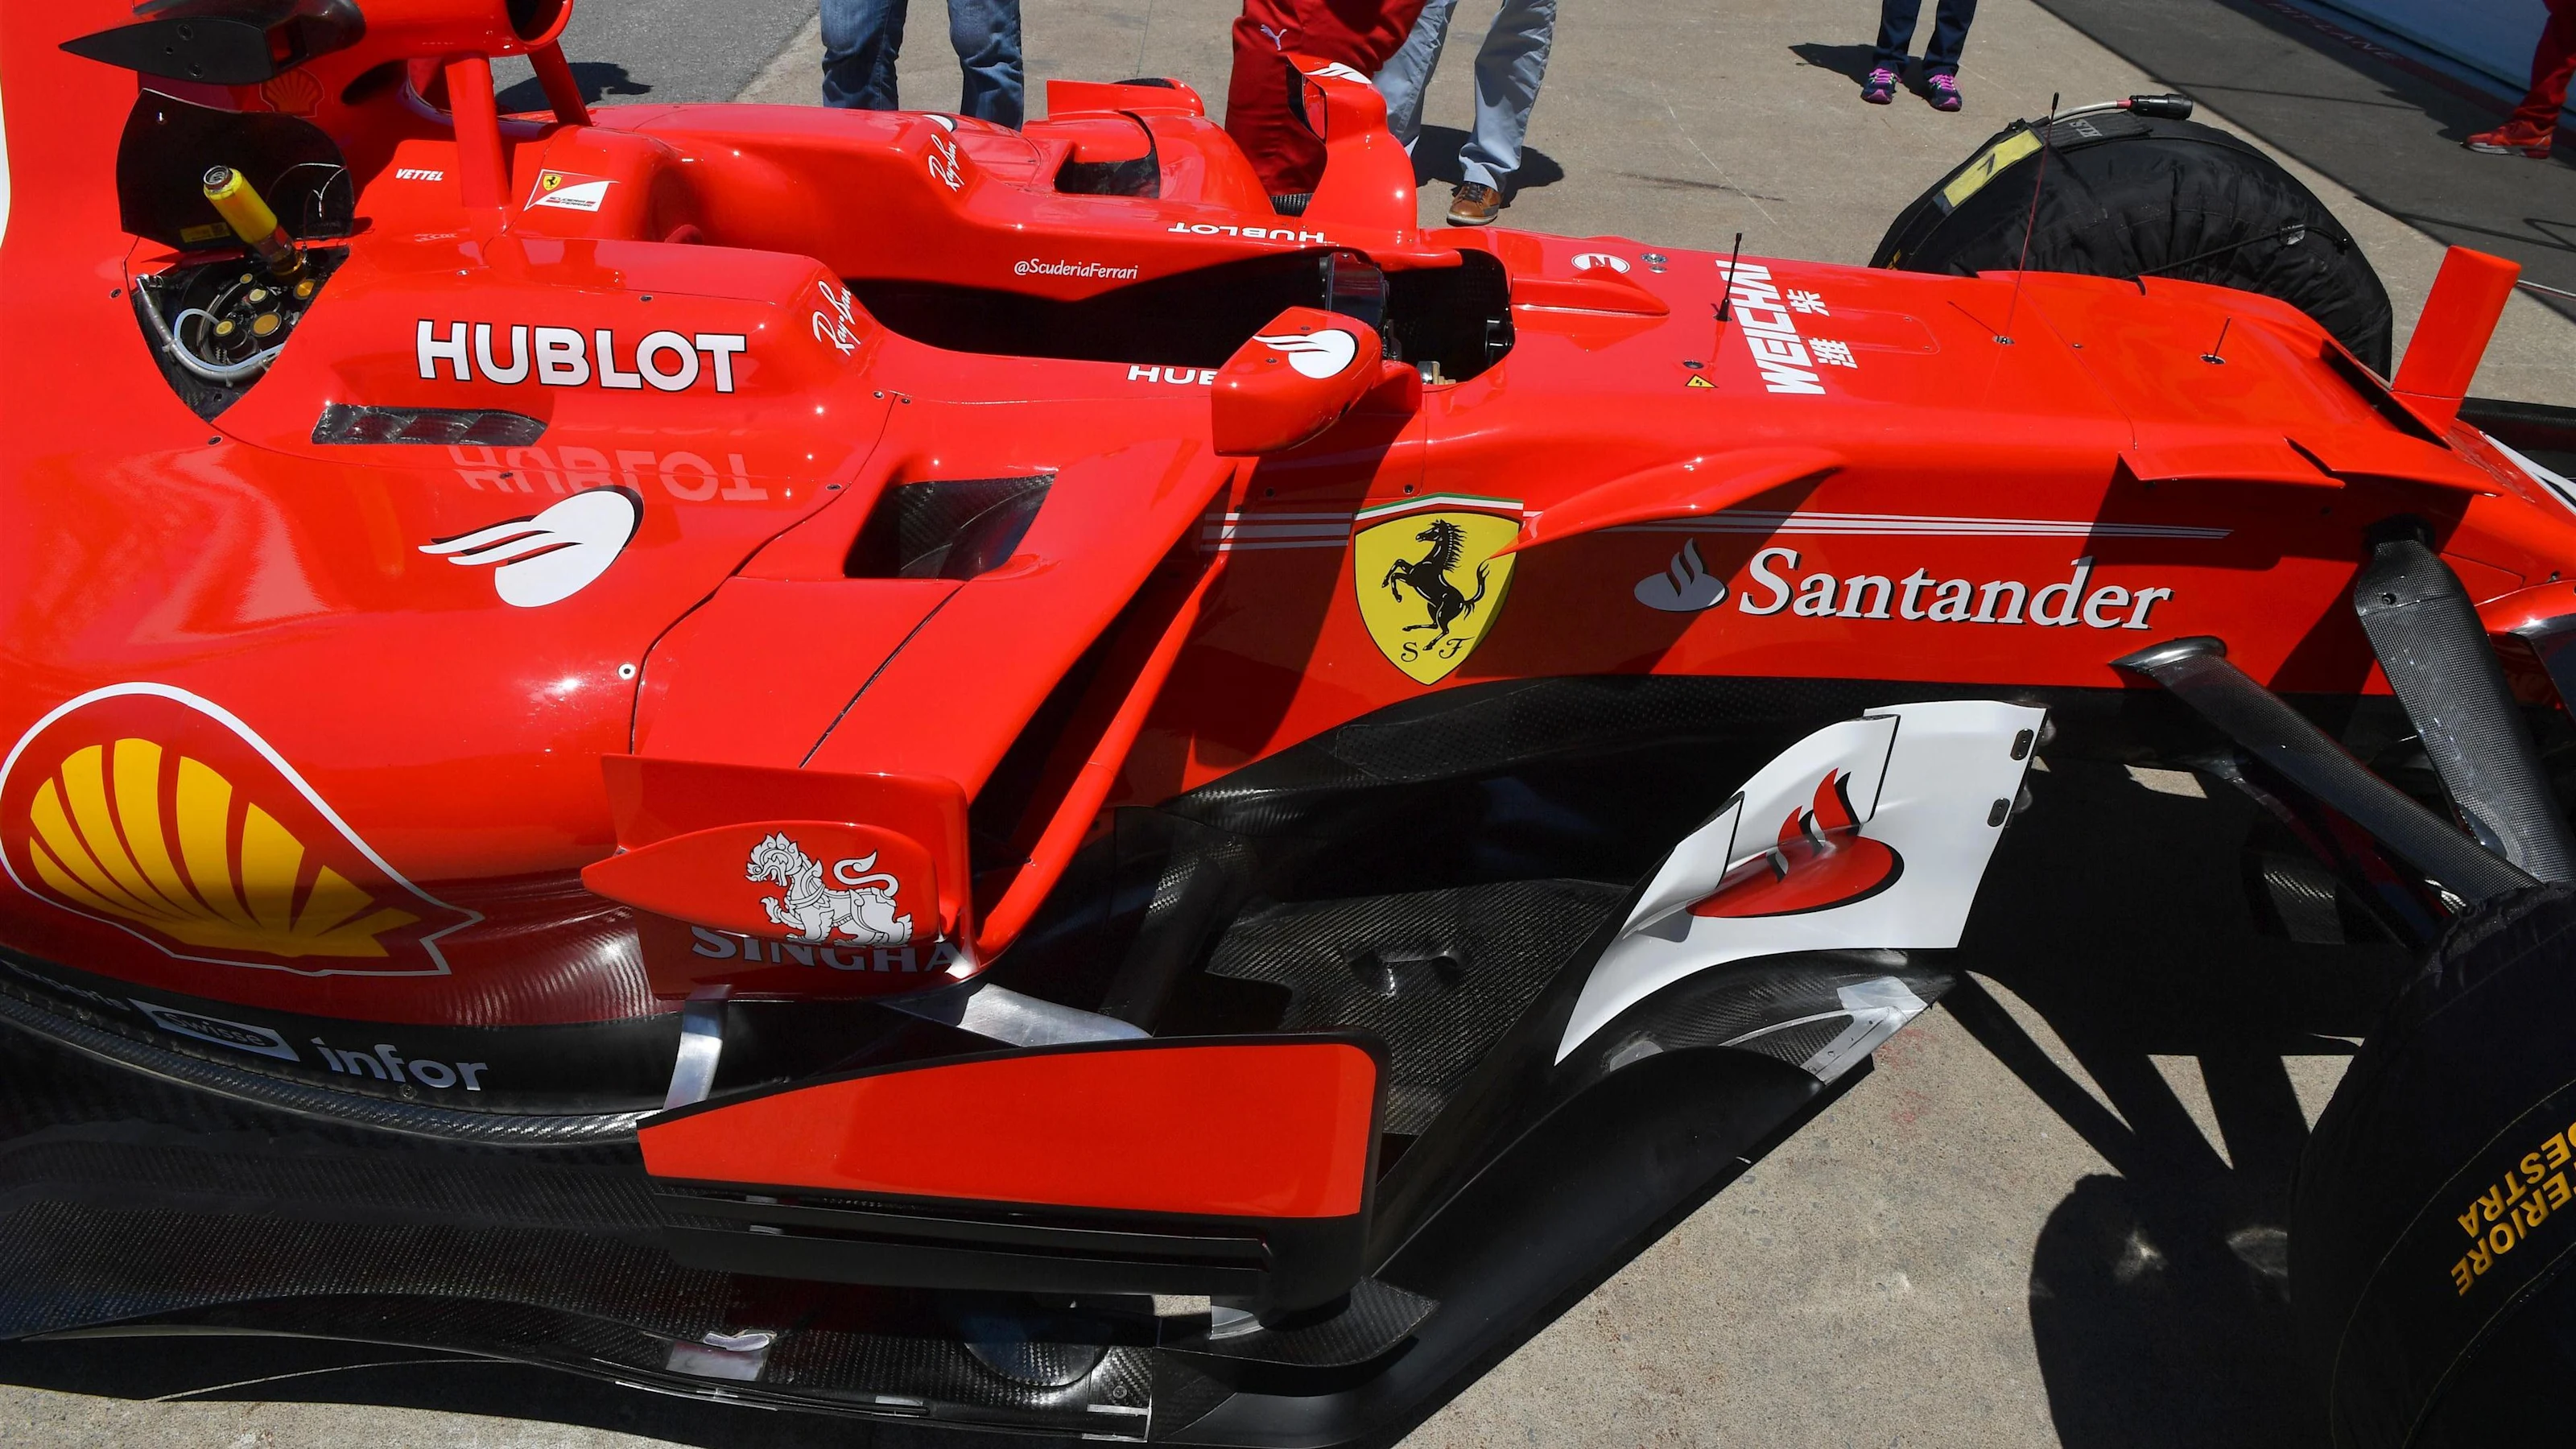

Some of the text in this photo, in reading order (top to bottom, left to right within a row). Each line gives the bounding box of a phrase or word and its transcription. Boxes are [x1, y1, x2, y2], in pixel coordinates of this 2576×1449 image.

[394, 168, 444, 181] VETTEL
[1167, 221, 1325, 245] HUBLOT
[1013, 258, 1139, 280] @ScuderiaFerrari
[416, 319, 748, 394] HUBLOT
[1739, 547, 2174, 630] Santander
[1401, 642, 1418, 663] S
[163, 1011, 265, 1046] Swisse
[310, 1036, 489, 1092] infor
